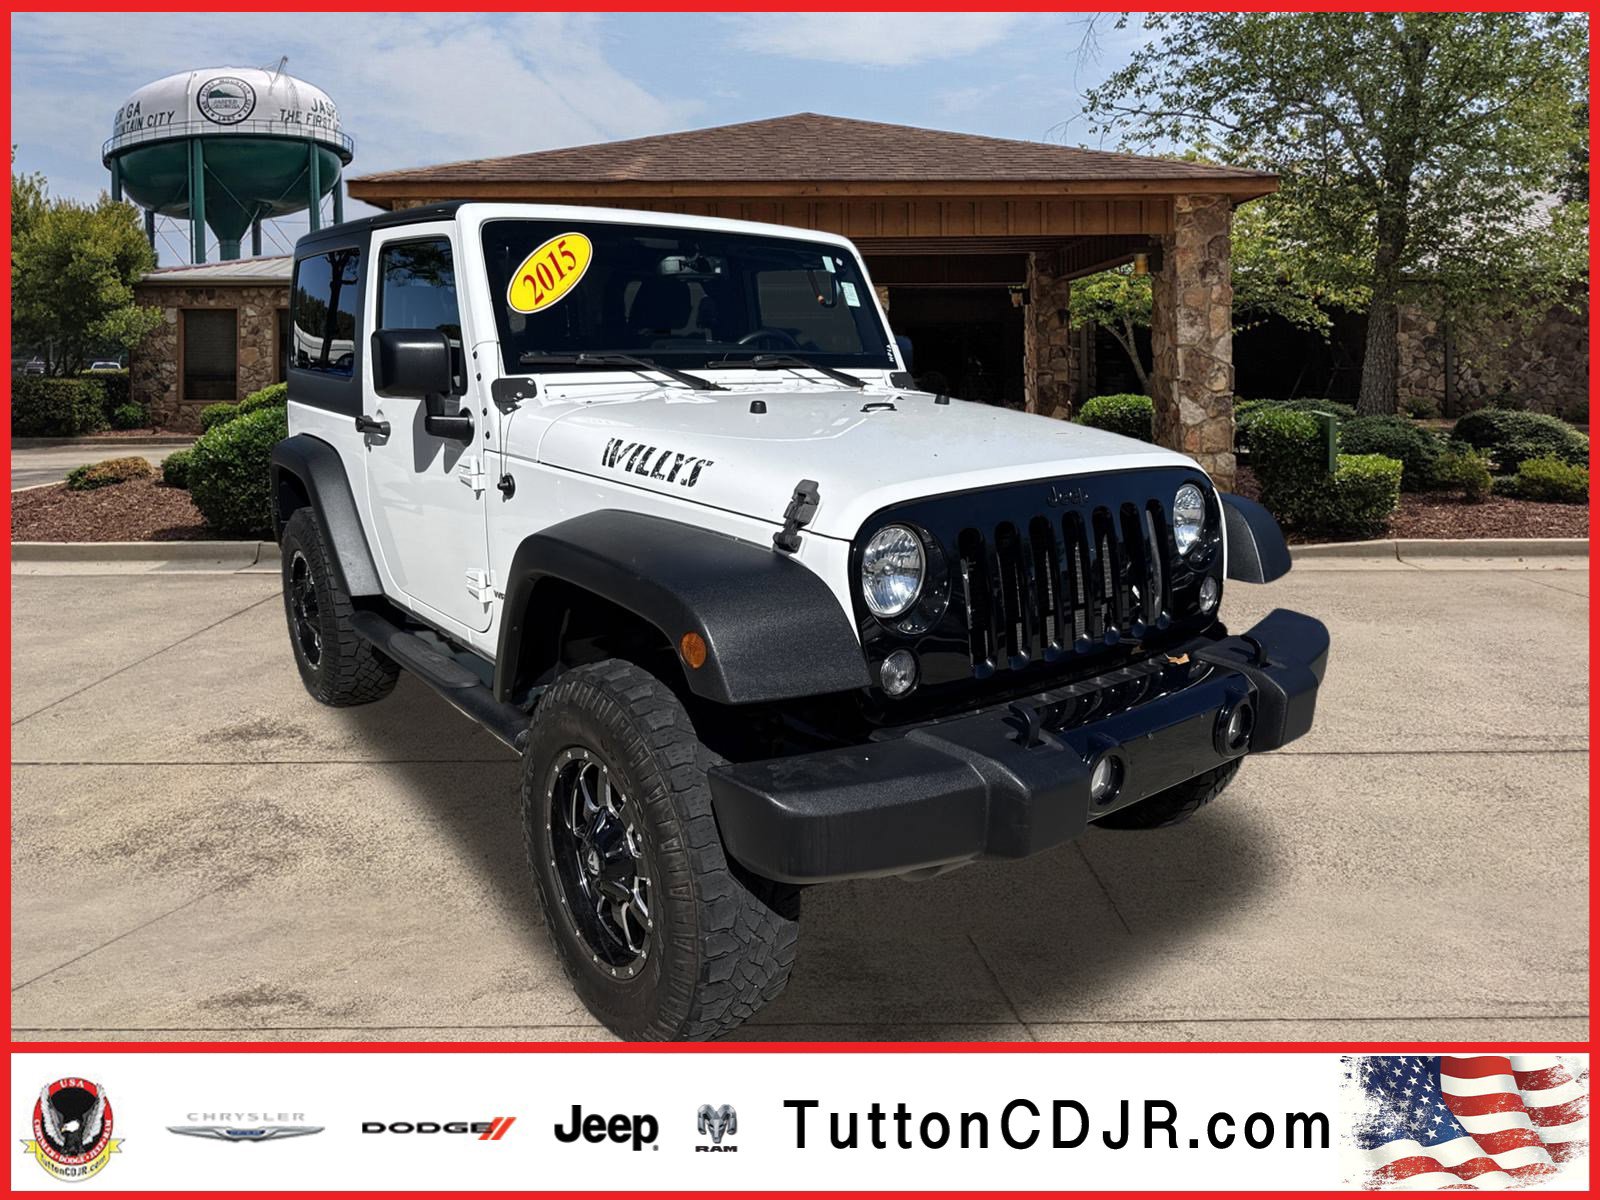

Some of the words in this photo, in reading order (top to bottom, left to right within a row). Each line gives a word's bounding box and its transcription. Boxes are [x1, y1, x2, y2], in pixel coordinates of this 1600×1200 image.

[126, 100, 141, 119] GA
[147, 110, 175, 127] CITY
[279, 108, 302, 124] THE
[522, 240, 577, 305] 2015
[601, 437, 715, 487] WILLYS
